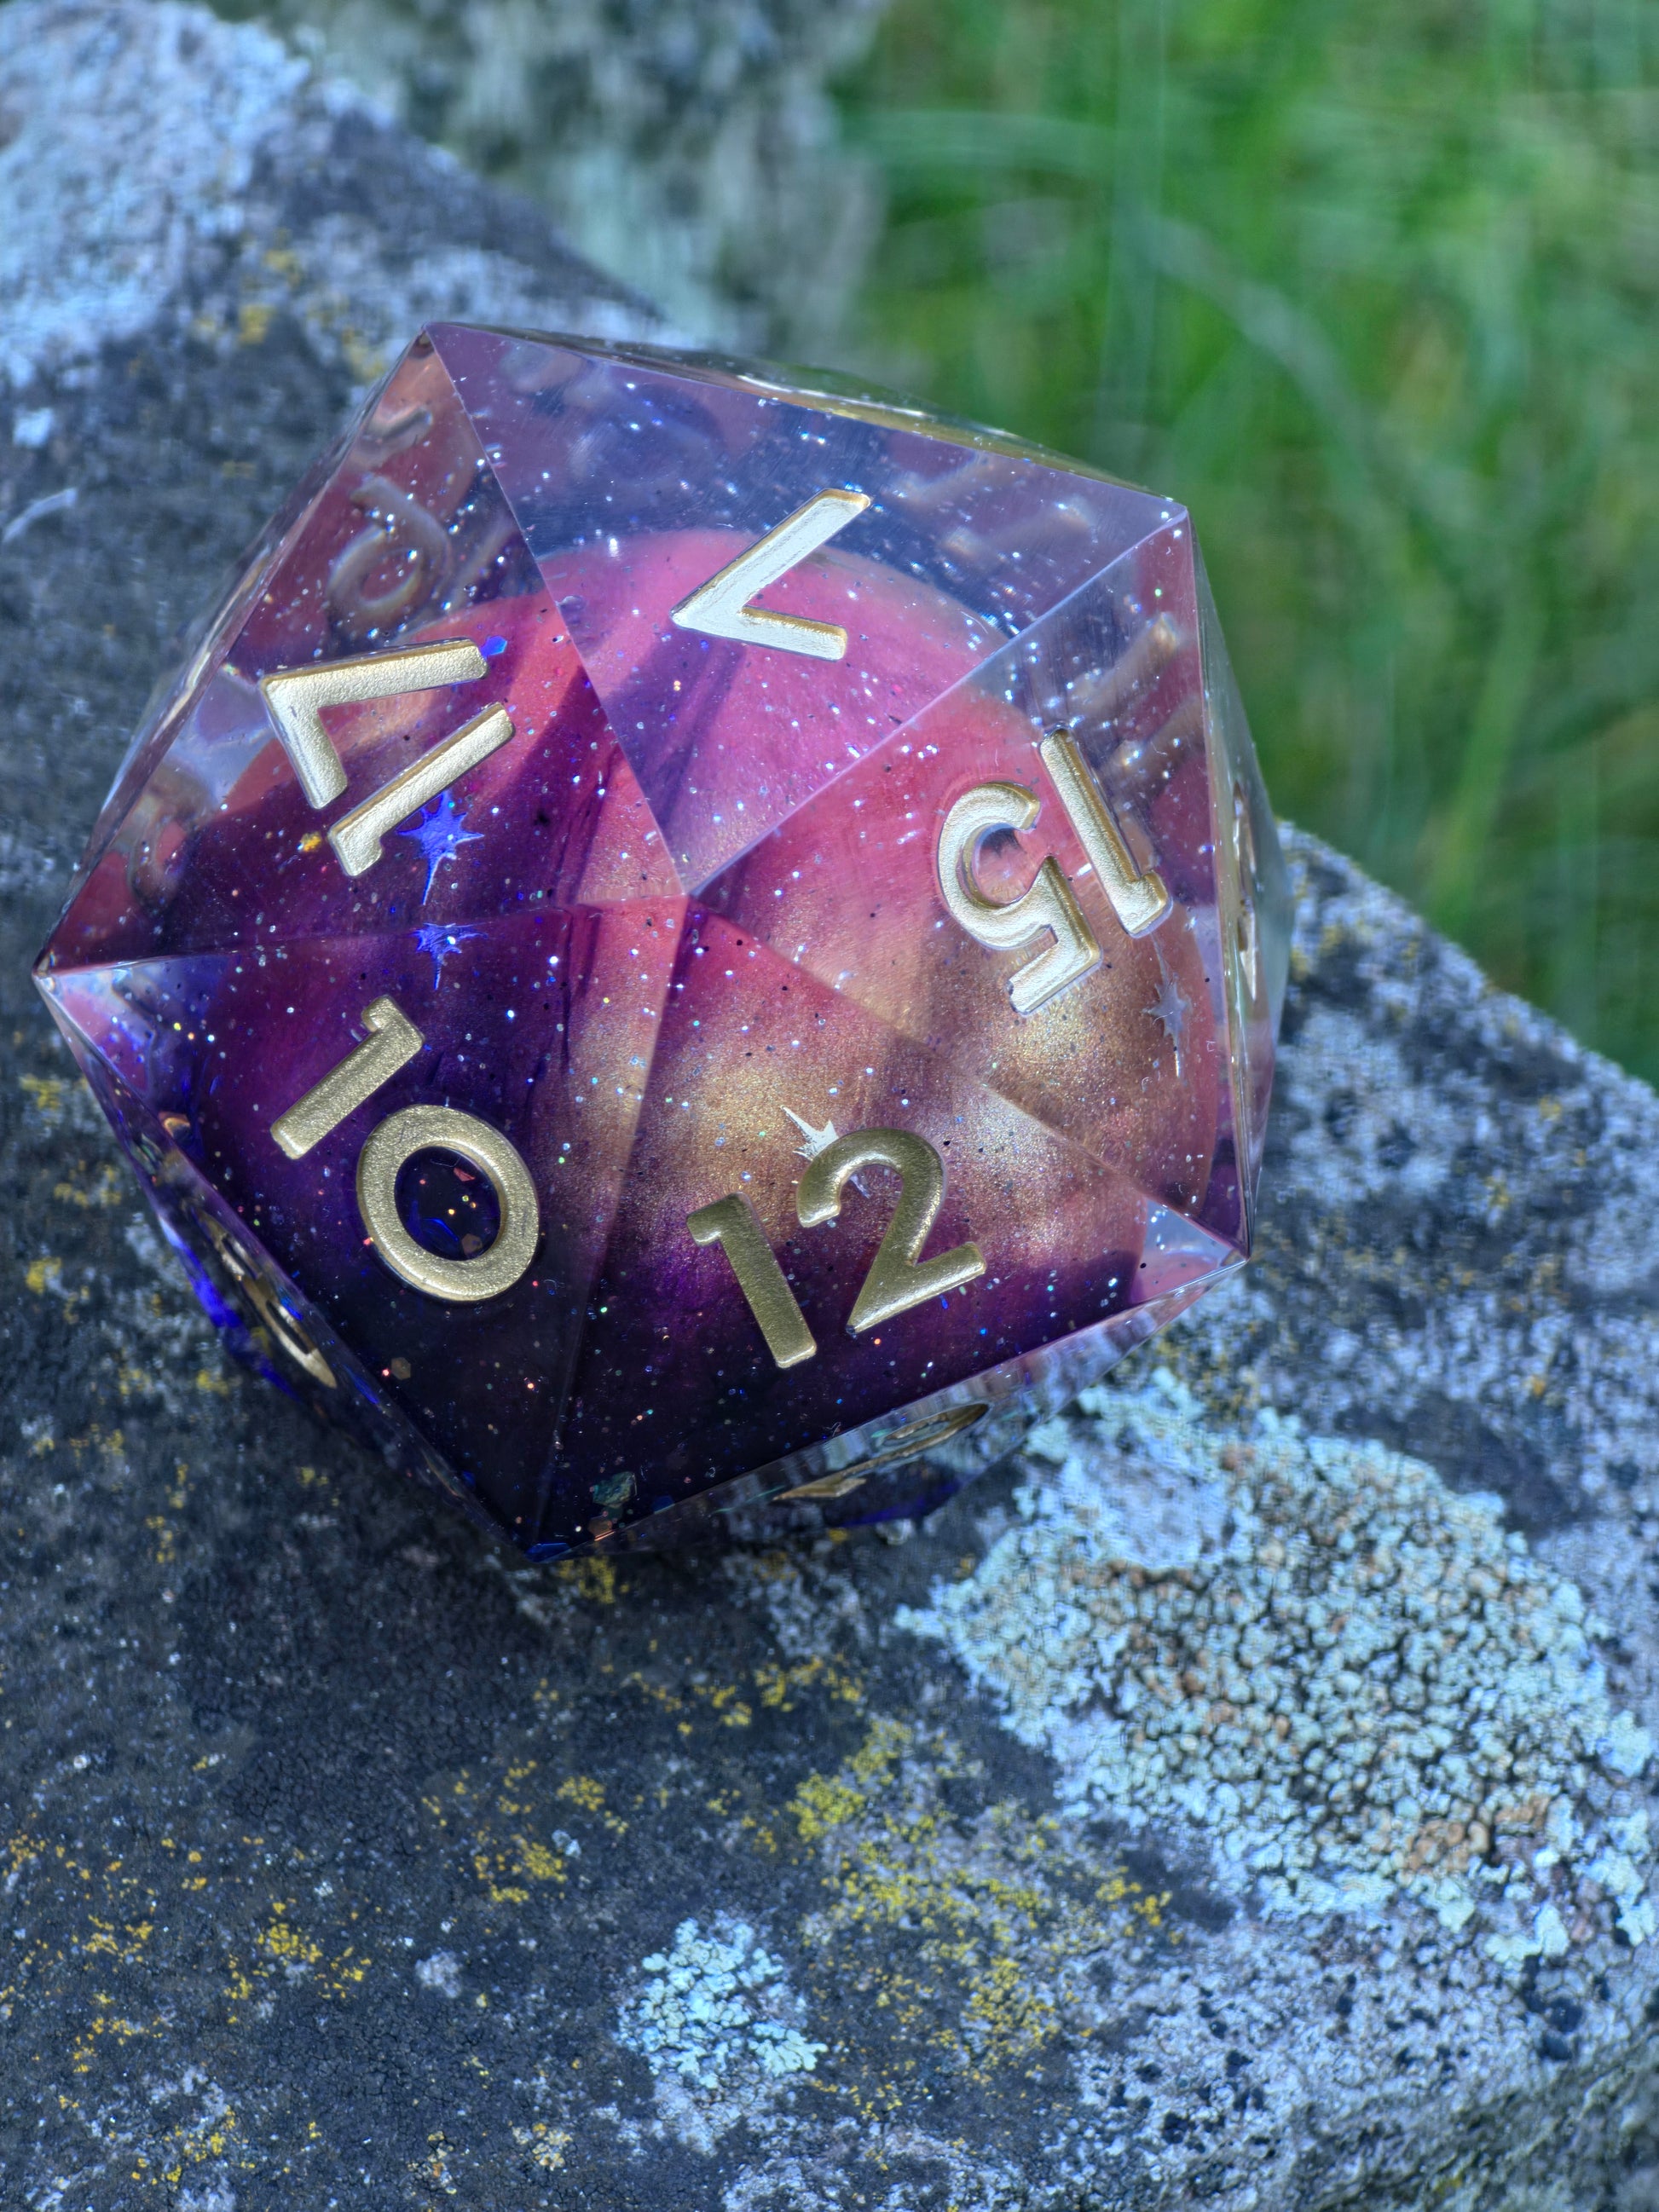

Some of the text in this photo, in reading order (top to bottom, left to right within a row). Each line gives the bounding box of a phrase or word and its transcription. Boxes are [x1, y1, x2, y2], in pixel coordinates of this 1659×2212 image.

[671, 488, 871, 661] 7
[261, 638, 516, 876] 17
[937, 725, 1172, 1016] 15
[270, 995, 539, 1302] 10
[685, 1128, 986, 1368] 12
